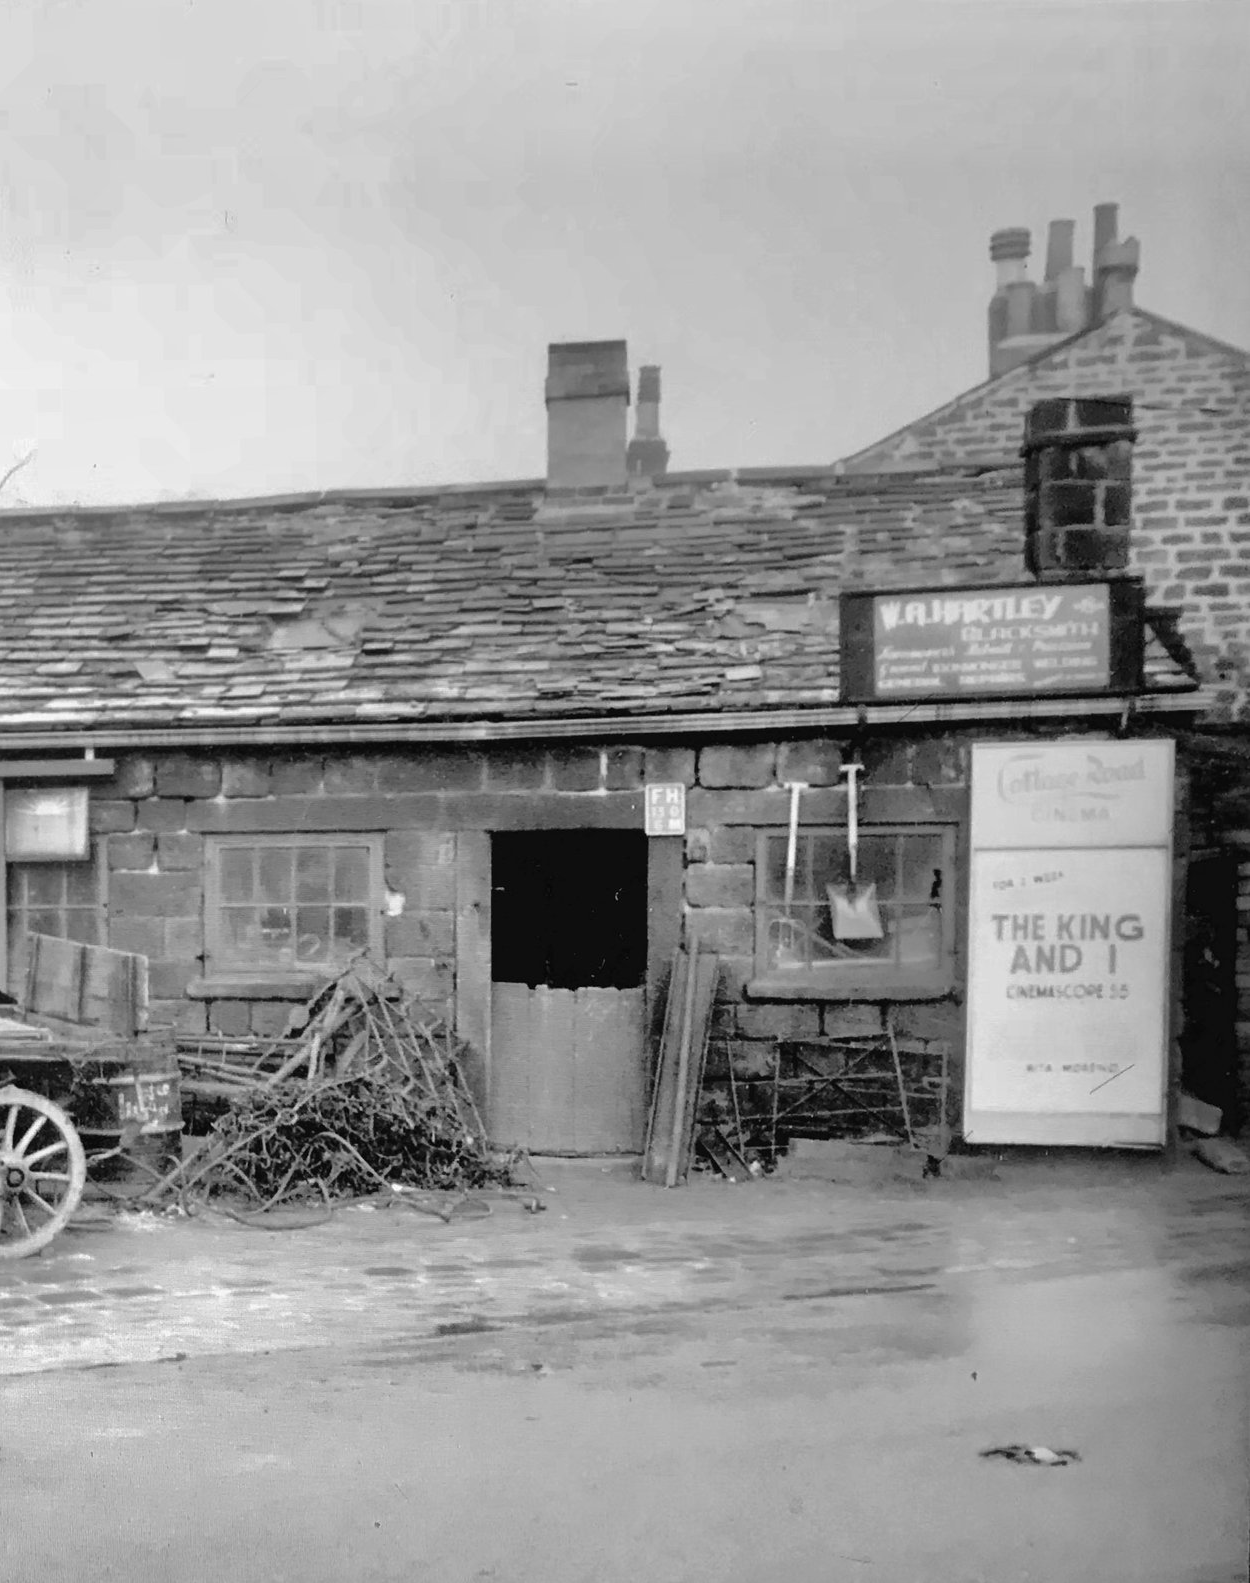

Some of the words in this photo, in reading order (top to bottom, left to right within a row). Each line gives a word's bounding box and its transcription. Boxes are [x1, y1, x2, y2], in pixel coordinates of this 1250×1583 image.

[1086, 754, 1146, 786] Road
[991, 913, 1045, 941] THE
[1056, 913, 1145, 942] KING
[1010, 943, 1083, 975] AND
[1108, 943, 1118, 975] I
[1006, 982, 1104, 1000] CINEMASCOPE
